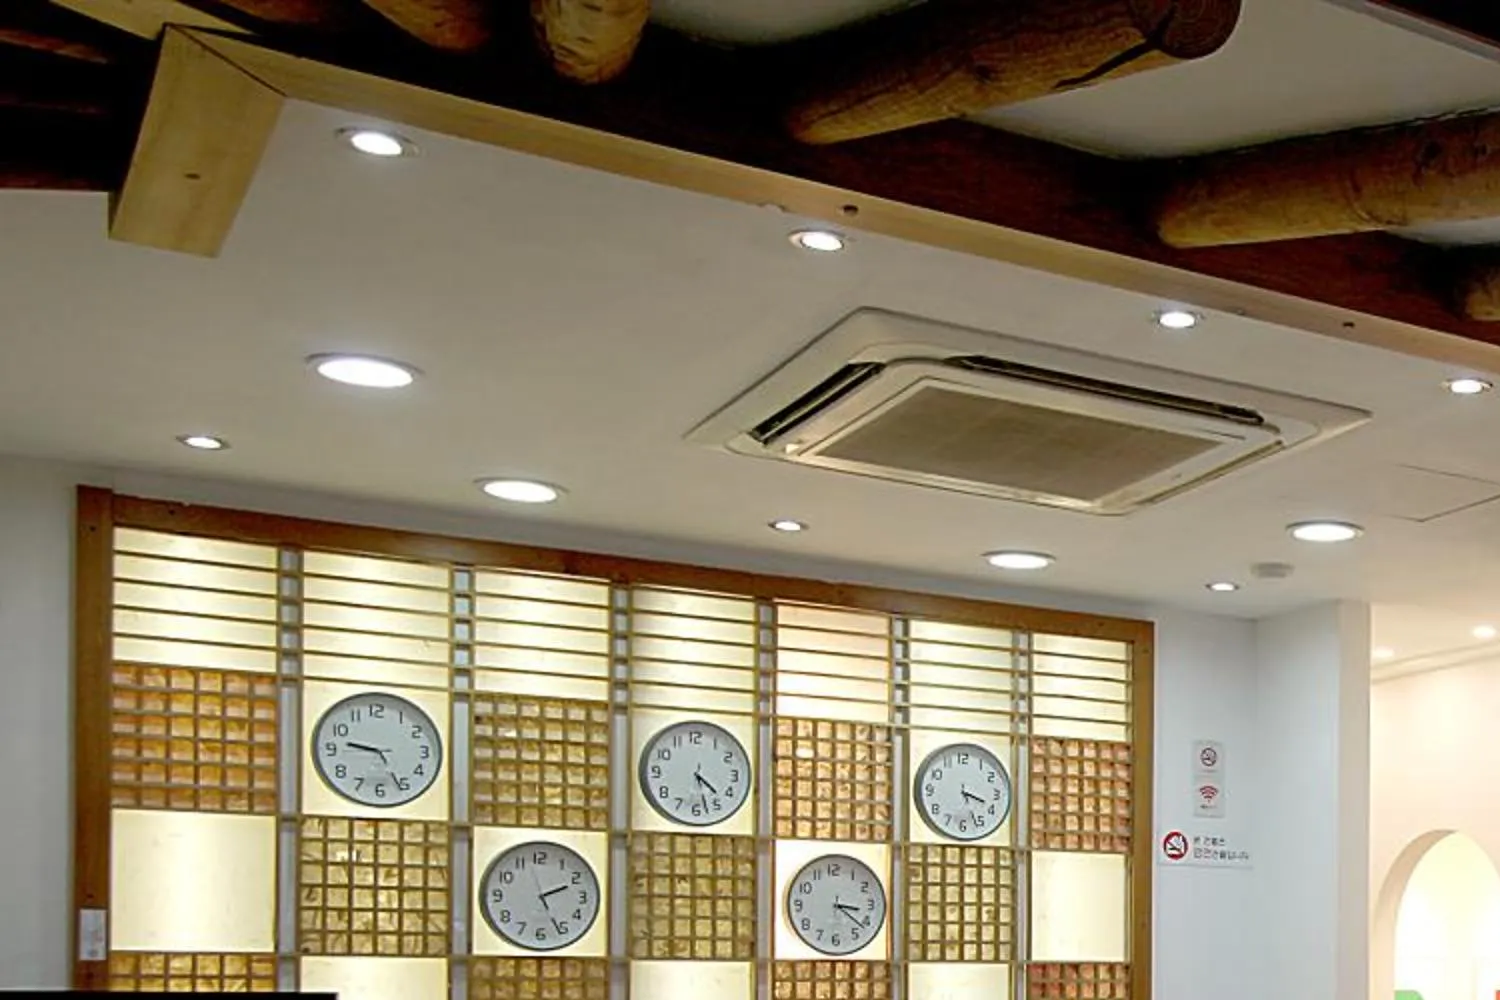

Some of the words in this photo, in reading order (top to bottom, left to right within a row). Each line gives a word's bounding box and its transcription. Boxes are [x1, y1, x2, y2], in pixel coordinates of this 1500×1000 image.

[351, 709, 361, 722] 11
[368, 704, 385, 719] 12
[332, 723, 349, 737] 10
[411, 725, 422, 739] 2
[673, 735, 683, 749] 11
[689, 731, 702, 745] 12
[326, 742, 337, 757] 9
[420, 745, 430, 759] 3
[657, 749, 671, 760] 10
[723, 752, 733, 763] 2
[943, 756, 952, 768] 11
[957, 752, 969, 765] 12
[335, 764, 347, 779] 8
[413, 764, 424, 776] 4
[651, 765, 661, 778] 9
[731, 769, 739, 782] 3
[987, 771, 995, 783] 2
[354, 777, 365, 791] 7
[375, 783, 385, 798] 6
[400, 777, 410, 791] 5
[925, 783, 934, 797] 9
[659, 785, 669, 798] 8
[725, 786, 733, 798] 4
[993, 788, 1001, 801] 3
[674, 797, 683, 811] 7
[691, 803, 701, 817] 6
[712, 798, 721, 811] 5
[987, 804, 995, 815] 4
[944, 814, 952, 826] 7
[959, 819, 967, 832] 6
[515, 857, 525, 869] 11
[533, 851, 547, 865] 12
[813, 869, 821, 881] 11
[827, 864, 841, 876] 12
[499, 871, 513, 884] 10
[571, 872, 581, 885] 2
[799, 881, 812, 894] 10
[860, 881, 869, 893] 2
[492, 889, 503, 902] 9
[579, 891, 587, 904] 3
[794, 900, 803, 912] 9
[867, 899, 875, 911] 3
[501, 909, 511, 923] 8
[572, 909, 581, 920] 4
[516, 921, 527, 935] 7
[559, 921, 569, 934] 5
[801, 918, 811, 931] 8
[535, 927, 546, 941] 6
[816, 929, 824, 941] 7
[831, 933, 840, 947] 6
[851, 927, 859, 940] 5
